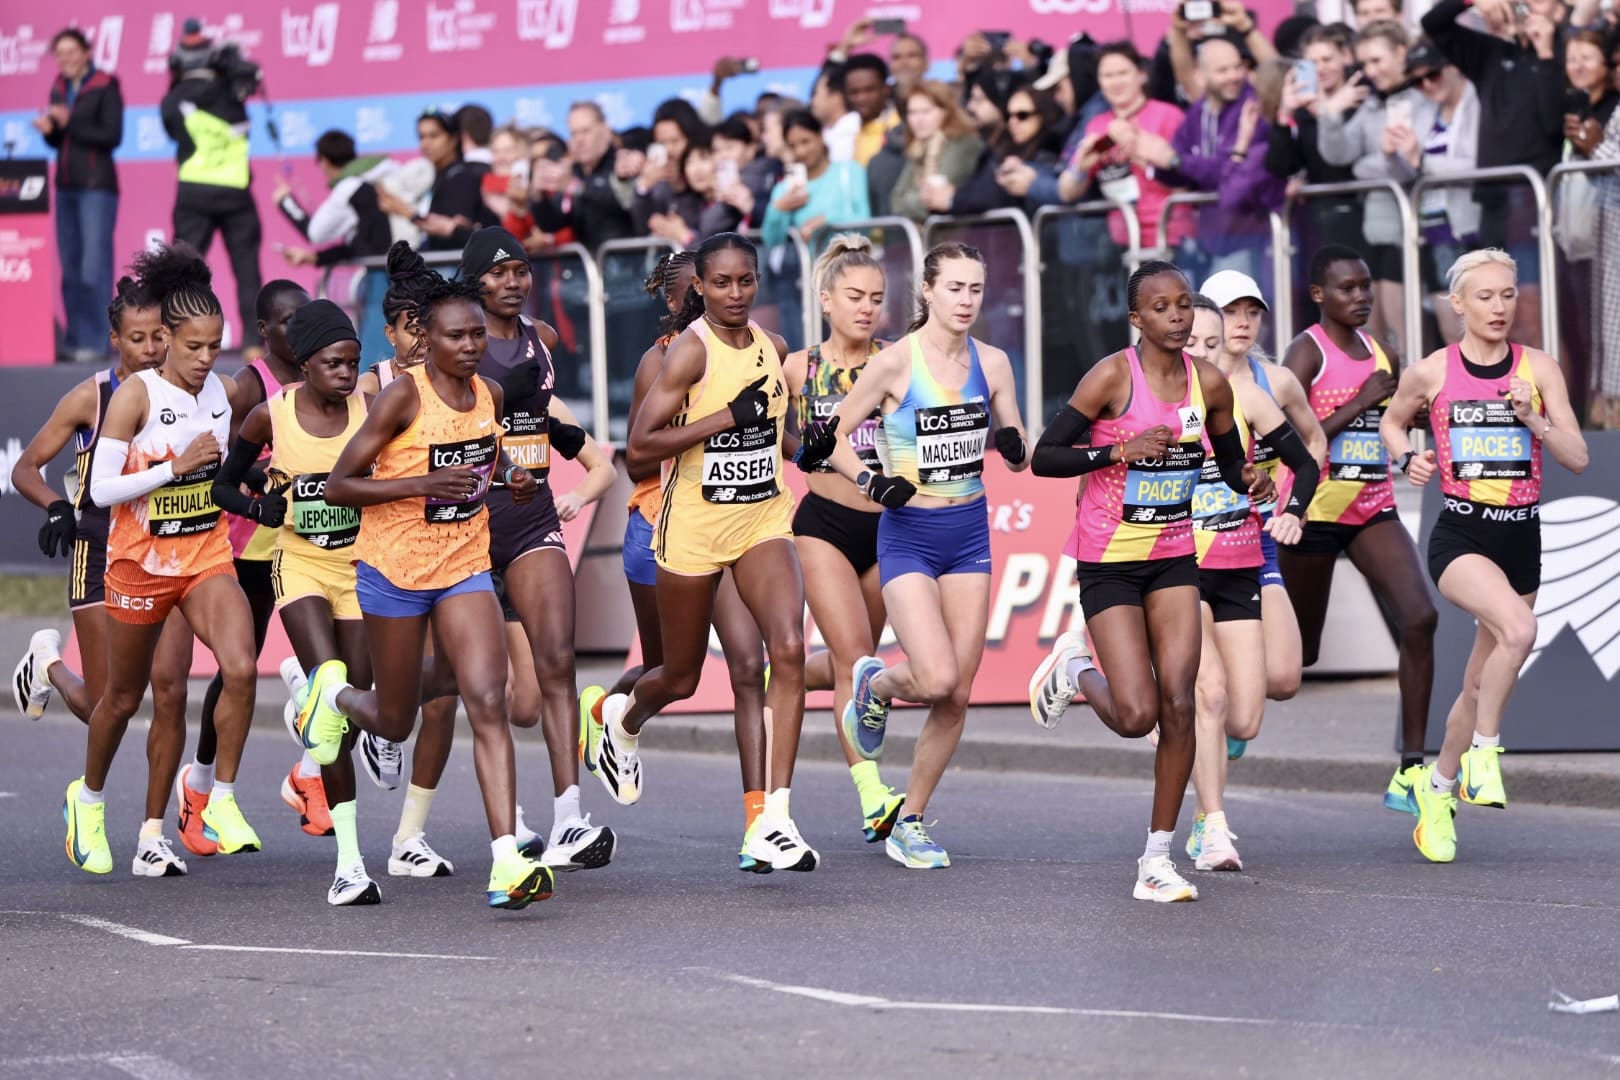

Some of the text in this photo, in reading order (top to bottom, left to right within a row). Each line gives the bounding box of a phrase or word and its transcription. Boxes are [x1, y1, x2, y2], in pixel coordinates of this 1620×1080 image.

[920, 413, 948, 431] tcs
[1453, 405, 1484, 423] tcs
[503, 443, 546, 465] PKIRUI
[922, 437, 983, 464] MACLENNAN
[1342, 440, 1380, 460] PACE
[1461, 436, 1522, 457] PACE 5
[434, 449, 462, 467] tcs
[708, 456, 774, 481] ASSEFA
[1137, 479, 1192, 502] PACE 3
[1482, 507, 1528, 521] NIKE
[110, 590, 154, 611] INEOS
